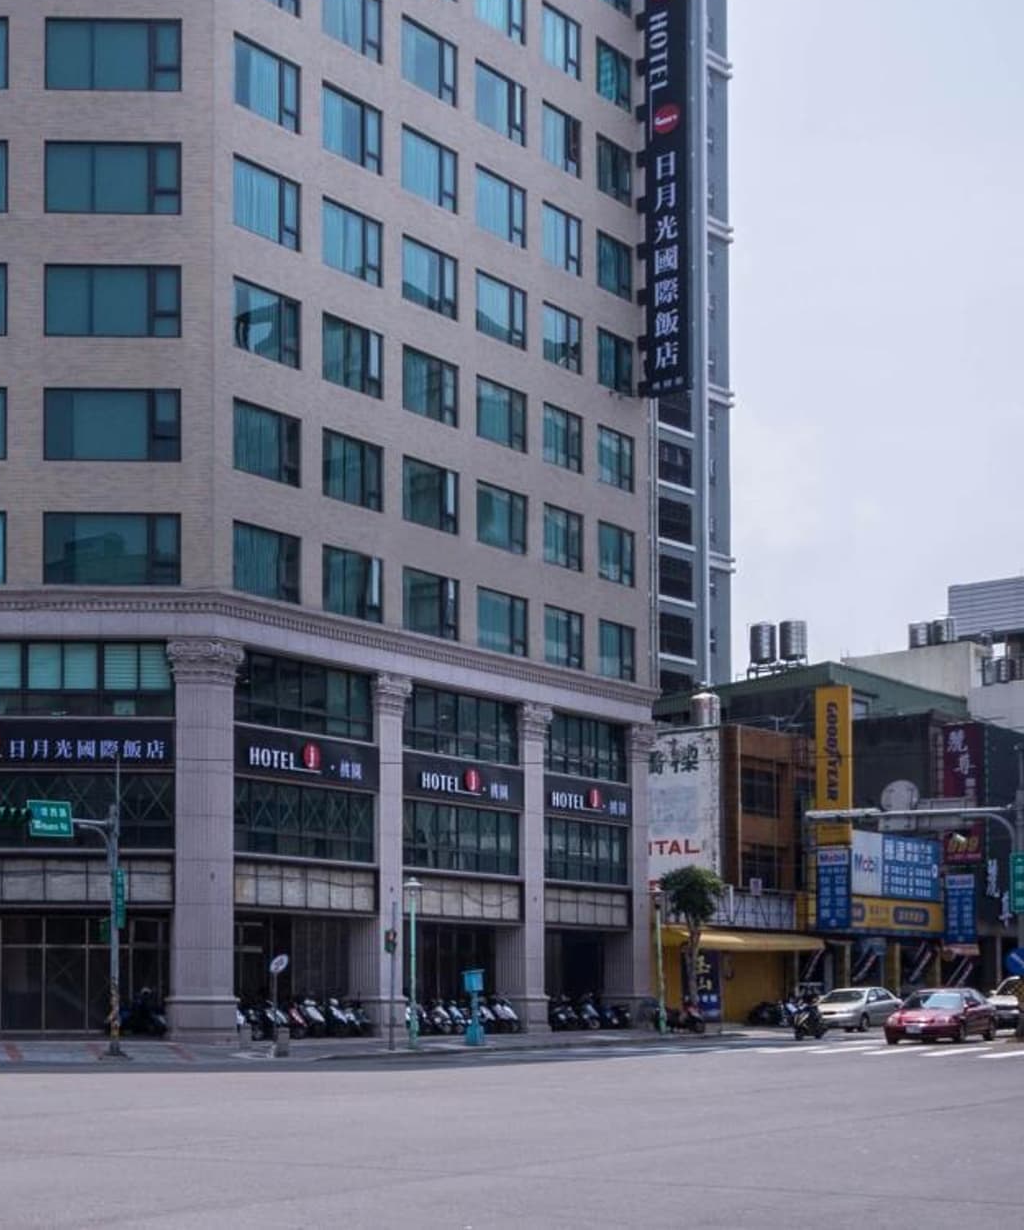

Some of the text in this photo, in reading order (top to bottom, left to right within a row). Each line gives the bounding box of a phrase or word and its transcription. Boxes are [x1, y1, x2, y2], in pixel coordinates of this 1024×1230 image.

[649, 11, 669, 91] HOTEL
[654, 151, 679, 370] 日月光國際飯店
[9, 739, 165, 759] 日月光國際飯店
[249, 746, 295, 770] HOTEL
[826, 701, 842, 801] GOODYEAR
[422, 772, 460, 793] HOTEL
[552, 791, 585, 810] HOTEL
